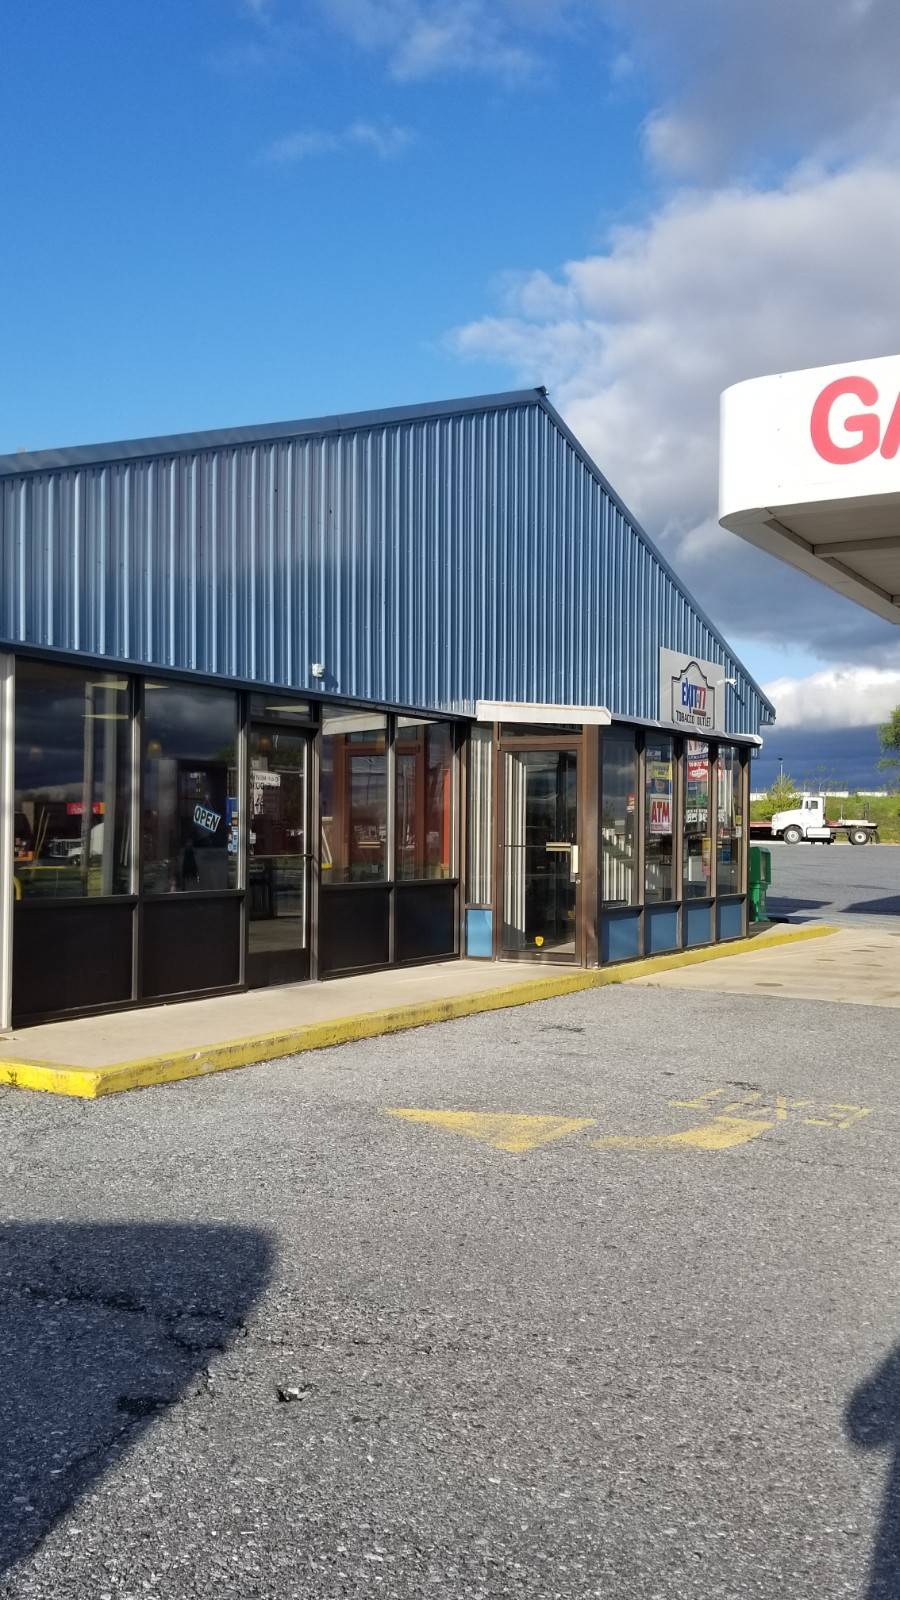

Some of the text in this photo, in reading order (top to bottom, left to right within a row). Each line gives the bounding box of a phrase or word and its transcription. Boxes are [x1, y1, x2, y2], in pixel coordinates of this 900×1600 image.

[810, 375, 900, 465] G
[676, 710, 711, 727] TOBACCO OUTLET
[193, 806, 220, 831] OPEN
[651, 801, 670, 823] ATM
